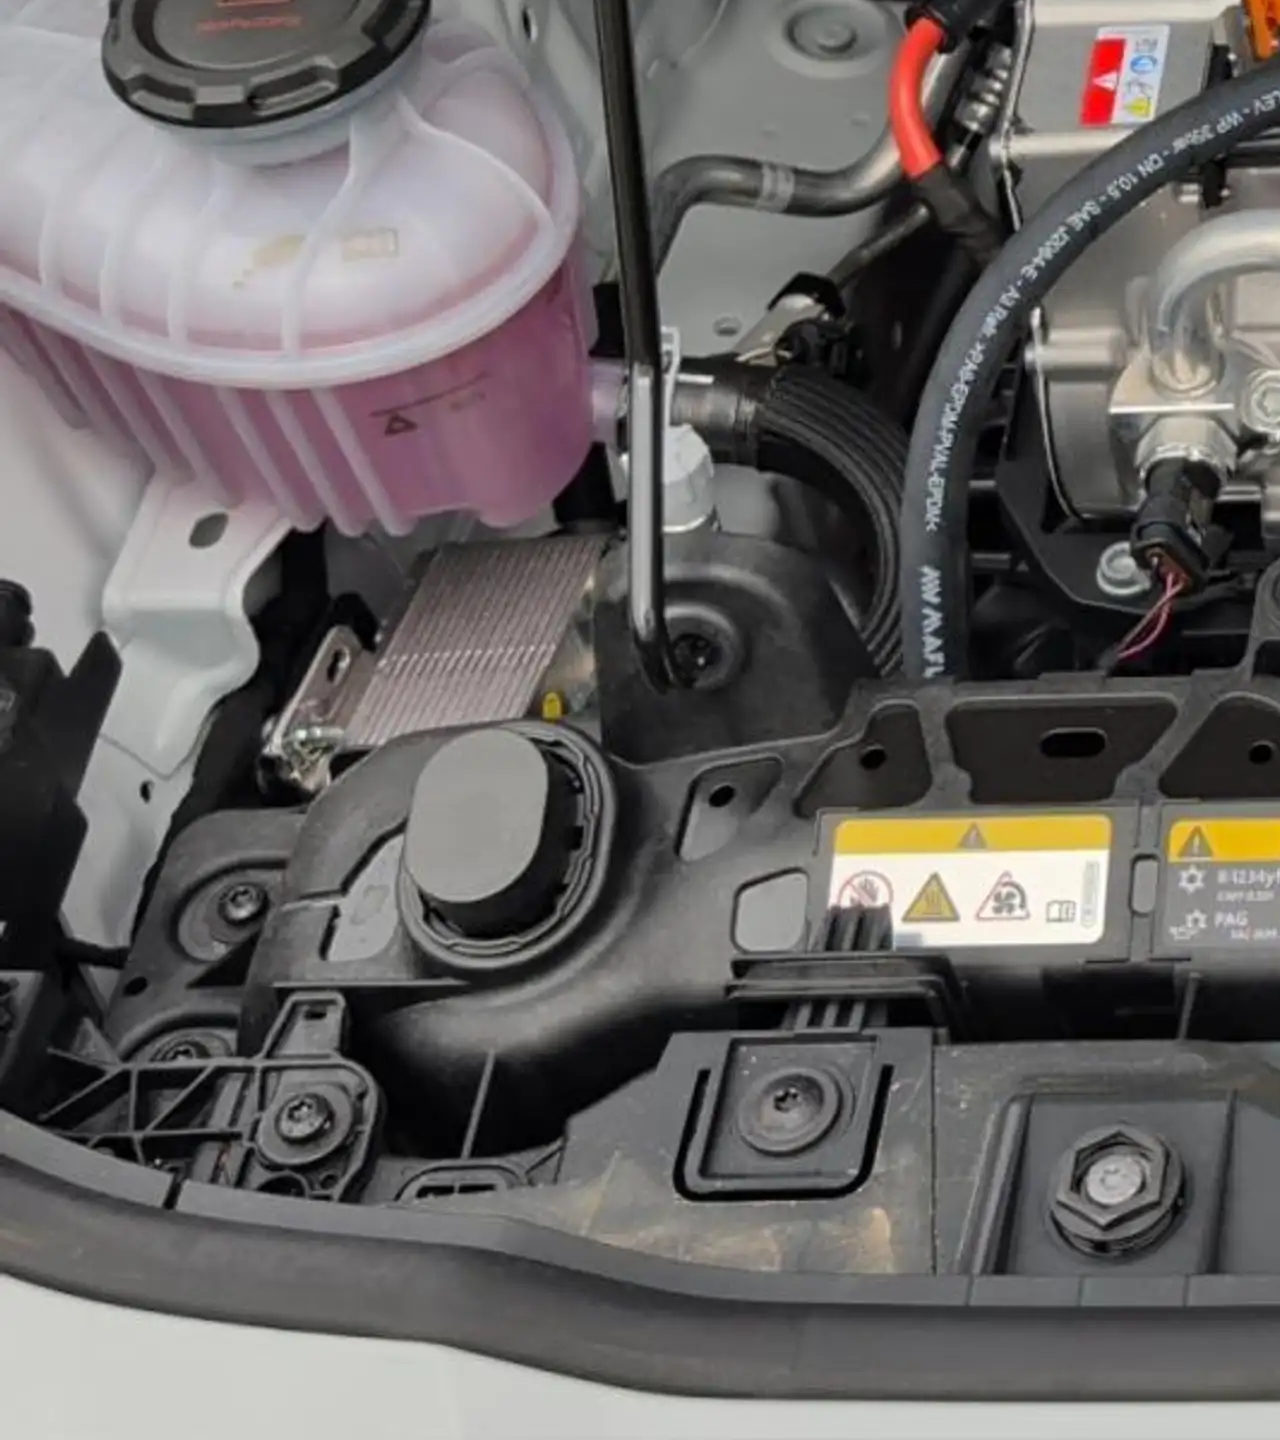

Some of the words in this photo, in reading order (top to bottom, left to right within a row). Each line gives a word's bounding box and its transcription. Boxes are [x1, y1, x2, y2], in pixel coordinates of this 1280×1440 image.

[1217, 113, 1244, 135] WP
[1137, 153, 1165, 178] DN
[1214, 910, 1249, 928] PAG
